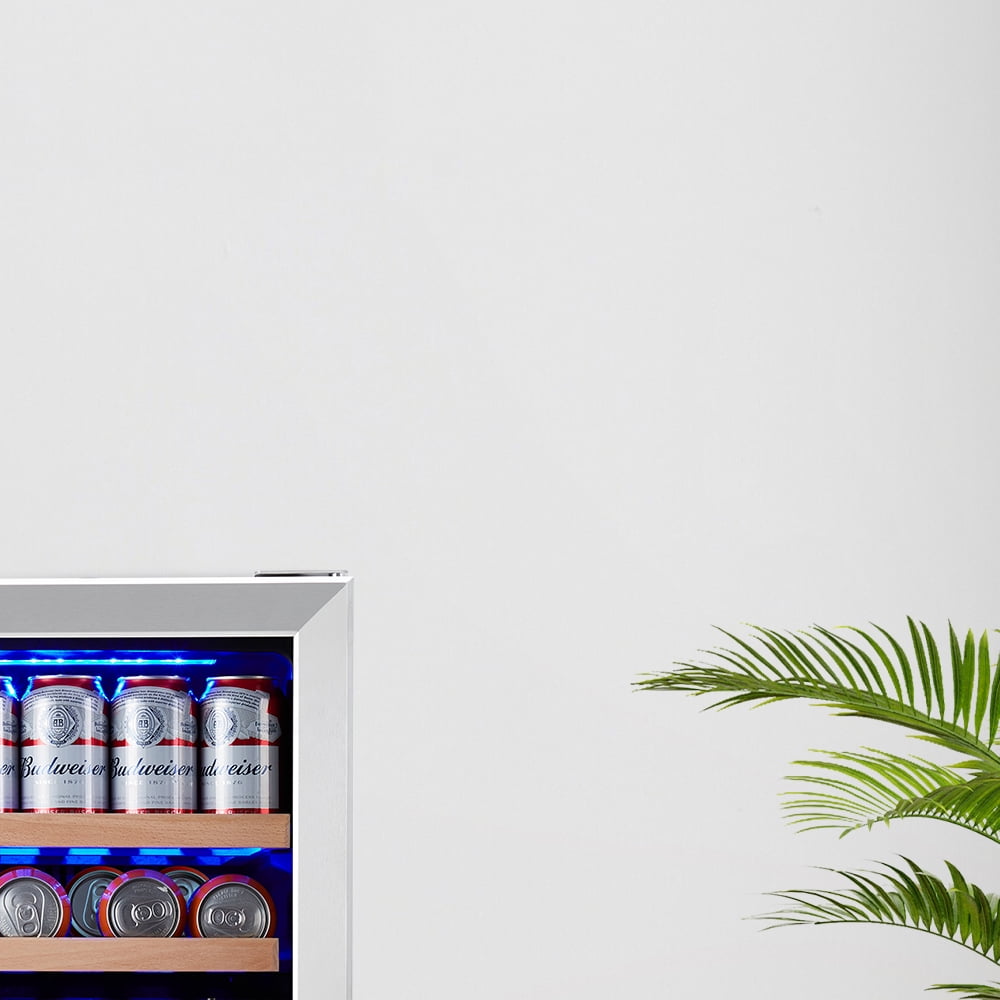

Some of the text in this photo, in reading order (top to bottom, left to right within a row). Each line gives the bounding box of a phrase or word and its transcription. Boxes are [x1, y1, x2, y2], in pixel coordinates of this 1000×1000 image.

[20, 755, 106, 779] Budweiser
[110, 756, 194, 780] Budweiser
[201, 758, 273, 777] udweiser
